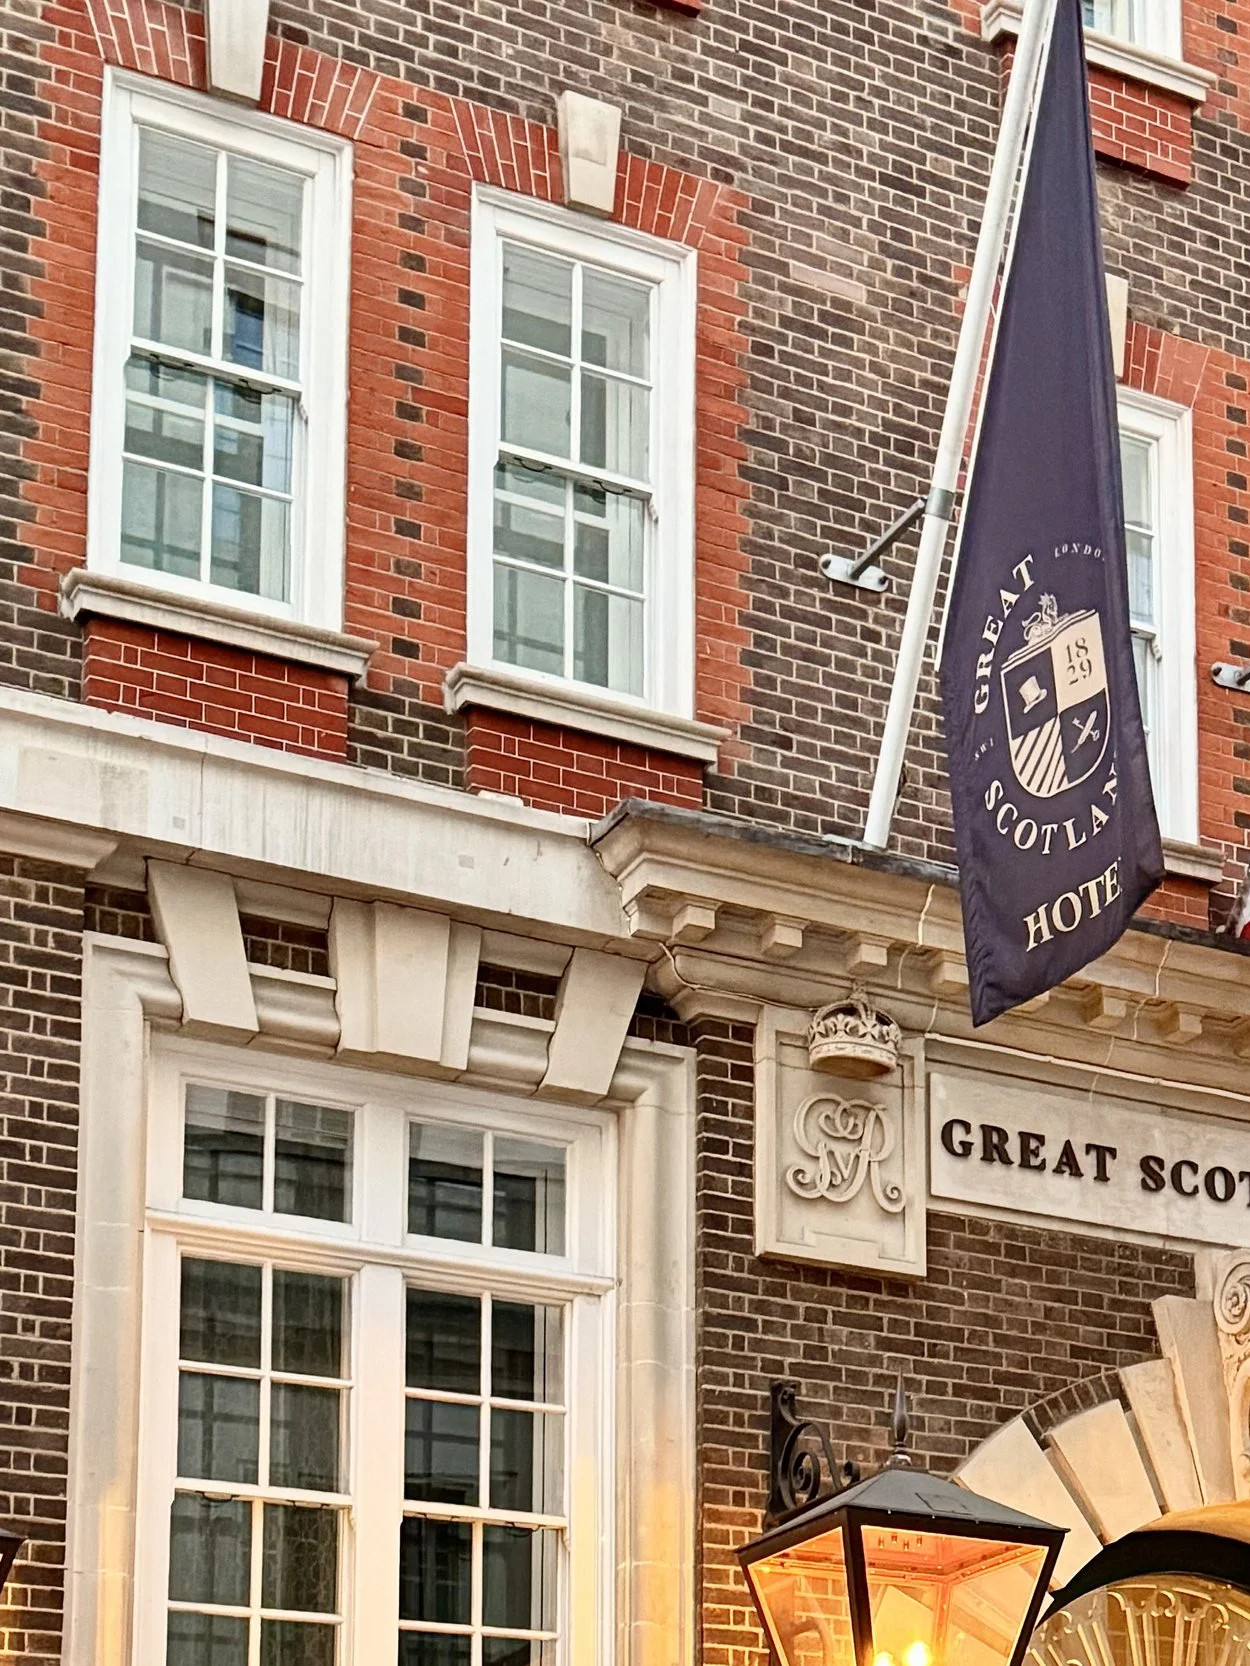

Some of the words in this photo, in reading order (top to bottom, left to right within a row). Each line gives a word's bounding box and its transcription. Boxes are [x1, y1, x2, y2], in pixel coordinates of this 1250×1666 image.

[1054, 543, 1104, 562] LONDO
[975, 554, 1034, 714] GREAT
[1067, 637, 1088, 663] 18
[1067, 658, 1092, 685] 29
[985, 757, 1118, 855] SCOTLAN
[1023, 857, 1123, 952] HOTE
[941, 1118, 1118, 1183] GREAT
